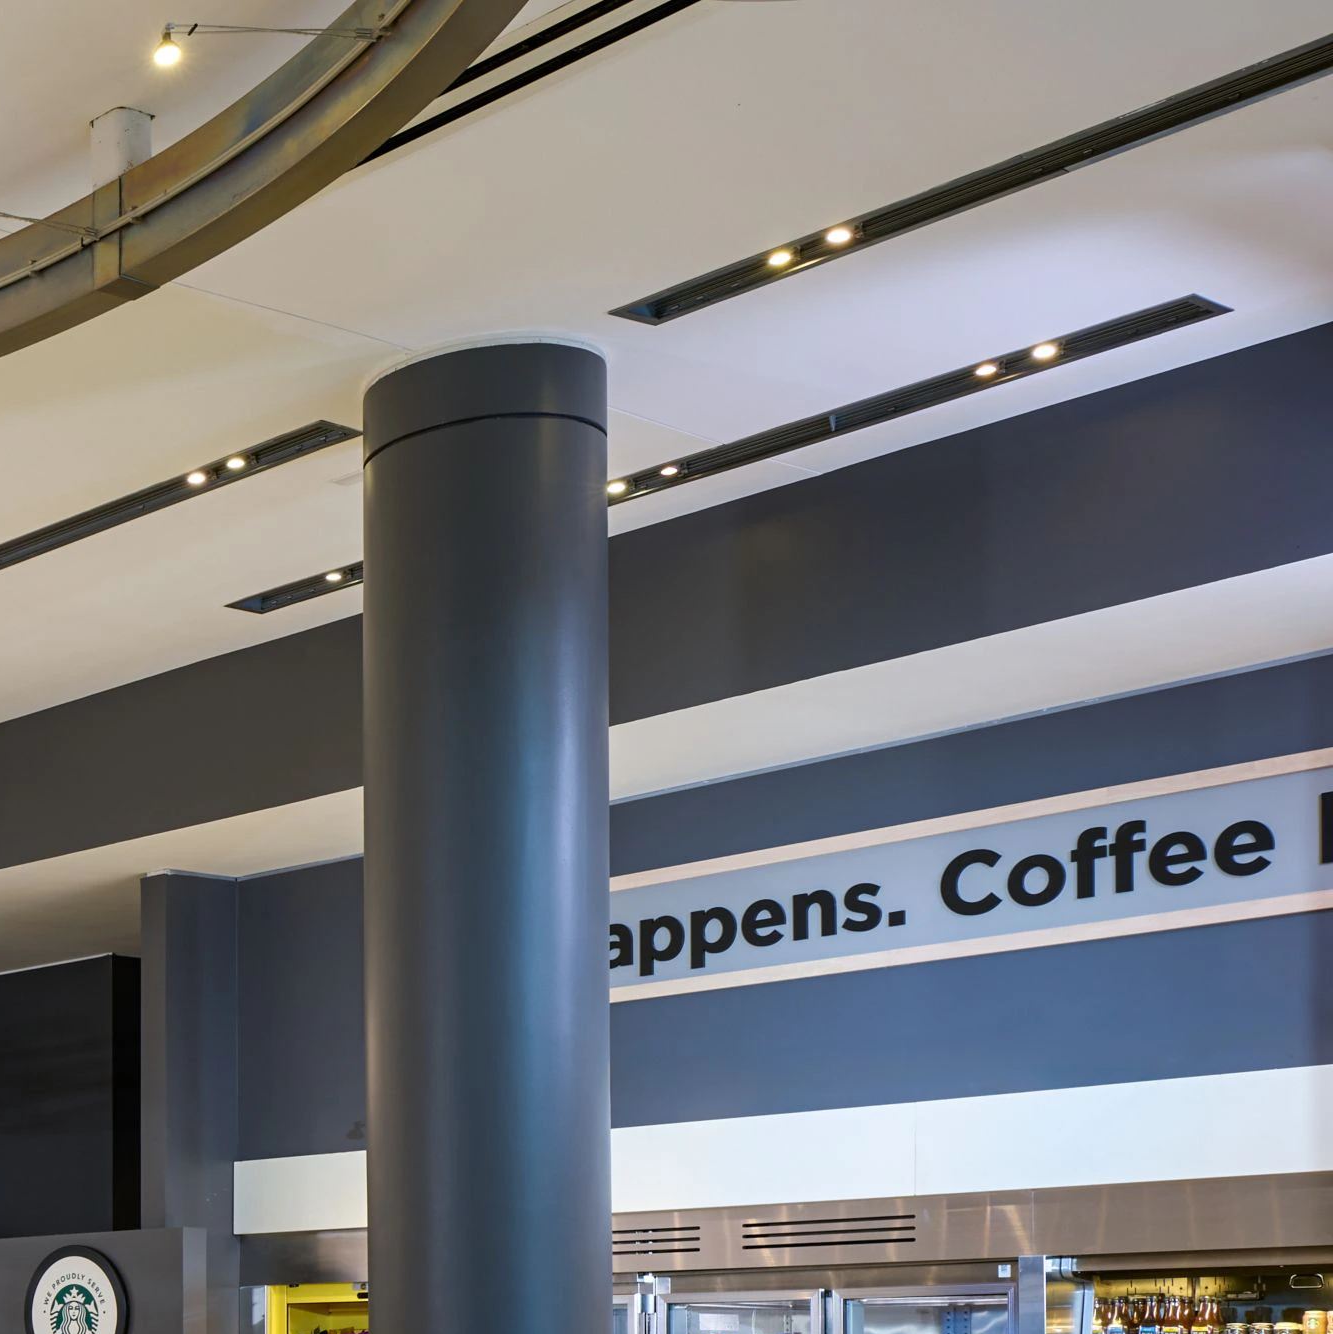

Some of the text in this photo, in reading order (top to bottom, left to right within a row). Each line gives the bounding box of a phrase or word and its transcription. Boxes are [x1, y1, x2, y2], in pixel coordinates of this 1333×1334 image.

[939, 820, 1276, 917] Coffee
[43, 1272, 106, 1306] WE PROUDLY SERVE
